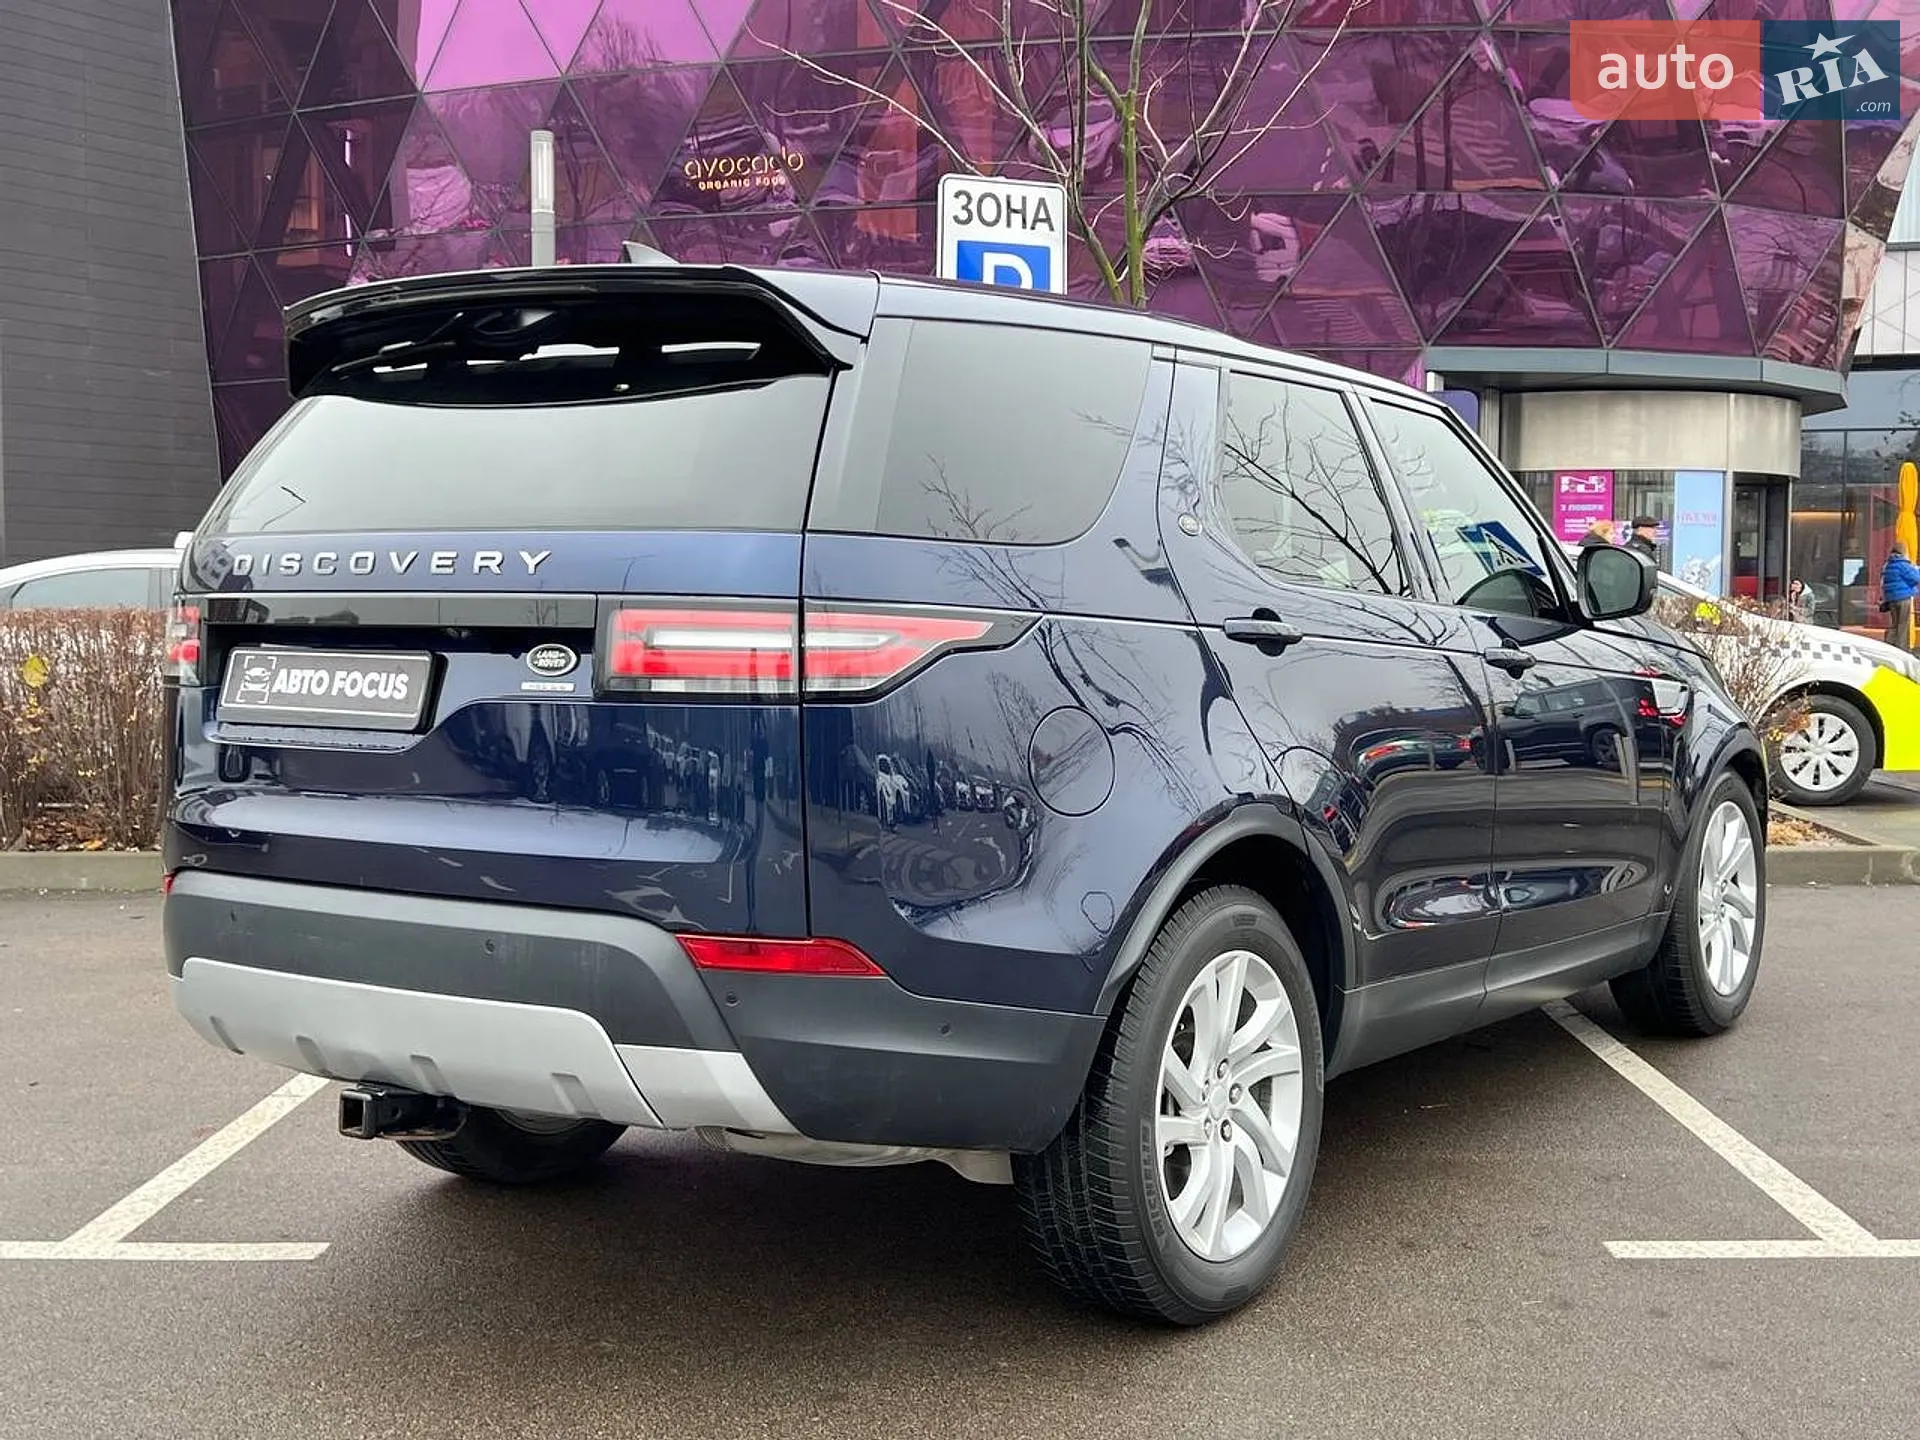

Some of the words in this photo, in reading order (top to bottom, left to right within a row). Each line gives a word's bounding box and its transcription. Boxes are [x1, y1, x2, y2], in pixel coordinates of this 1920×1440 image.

[684, 145, 804, 180] avocado
[698, 177, 750, 191] ORGANIC
[952, 189, 1055, 232] ЗОНА
[232, 550, 552, 577] DISCOVERY
[331, 670, 409, 700] FOCUS
